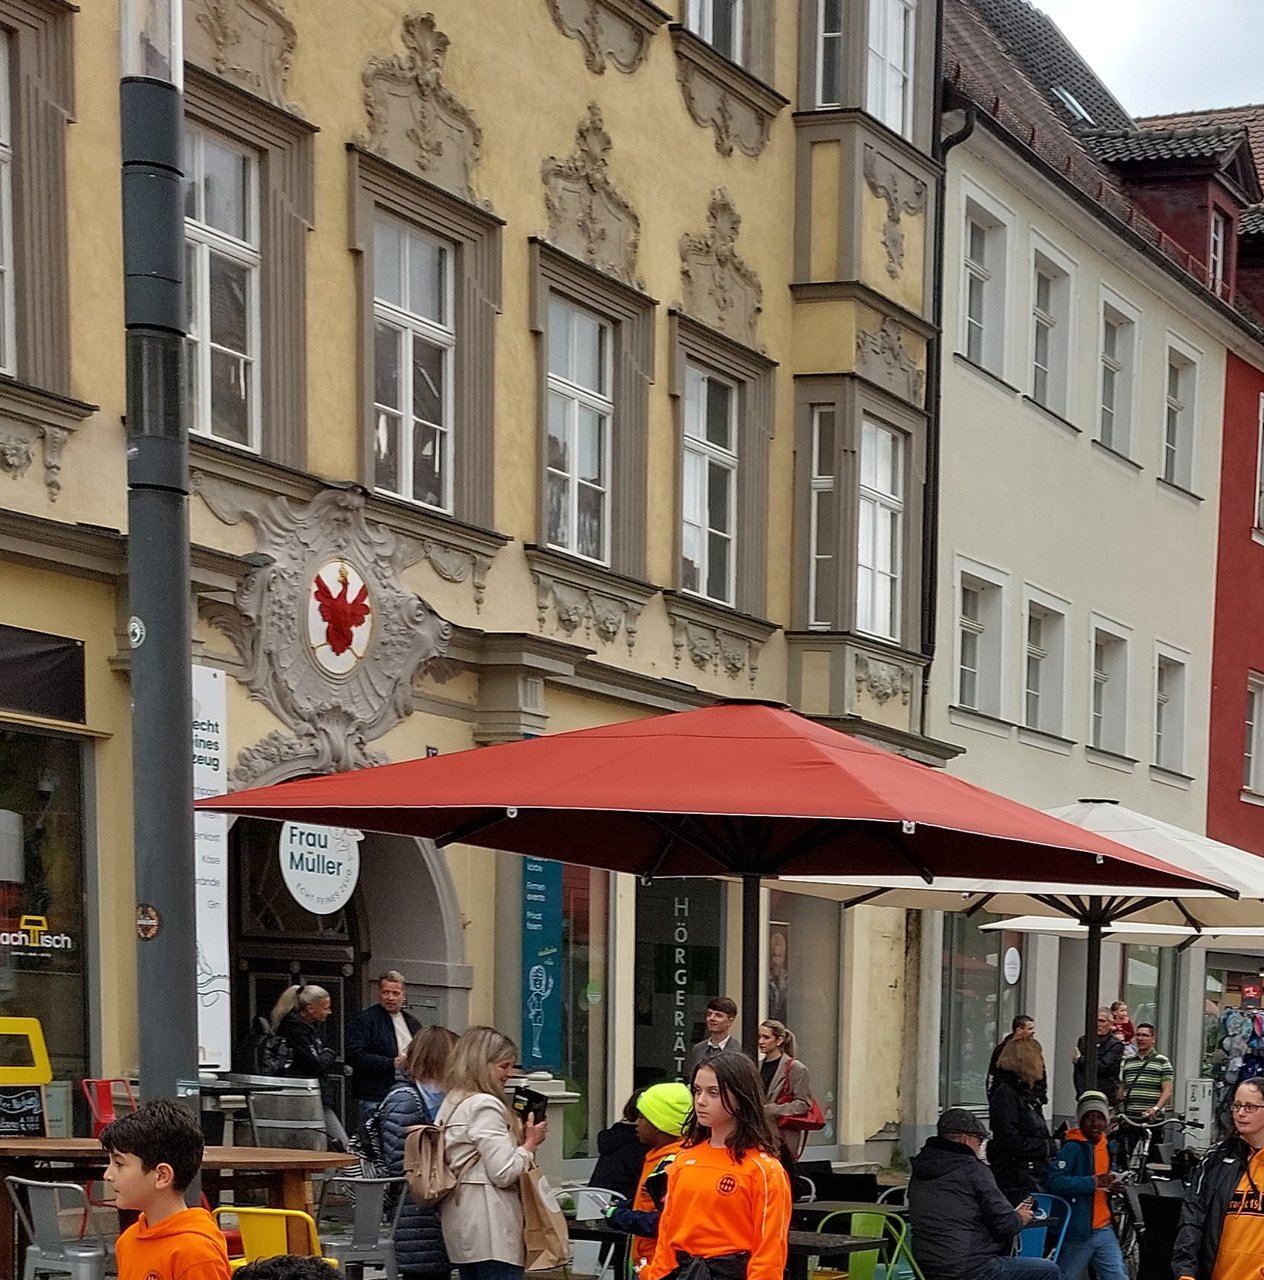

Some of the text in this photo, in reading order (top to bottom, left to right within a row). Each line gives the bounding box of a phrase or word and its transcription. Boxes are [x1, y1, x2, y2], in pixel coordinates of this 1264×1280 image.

[192, 720, 220, 734] echt
[193, 734, 220, 751] ines
[289, 826, 328, 848] Frau
[673, 897, 690, 1085] HÖRGERÄT
